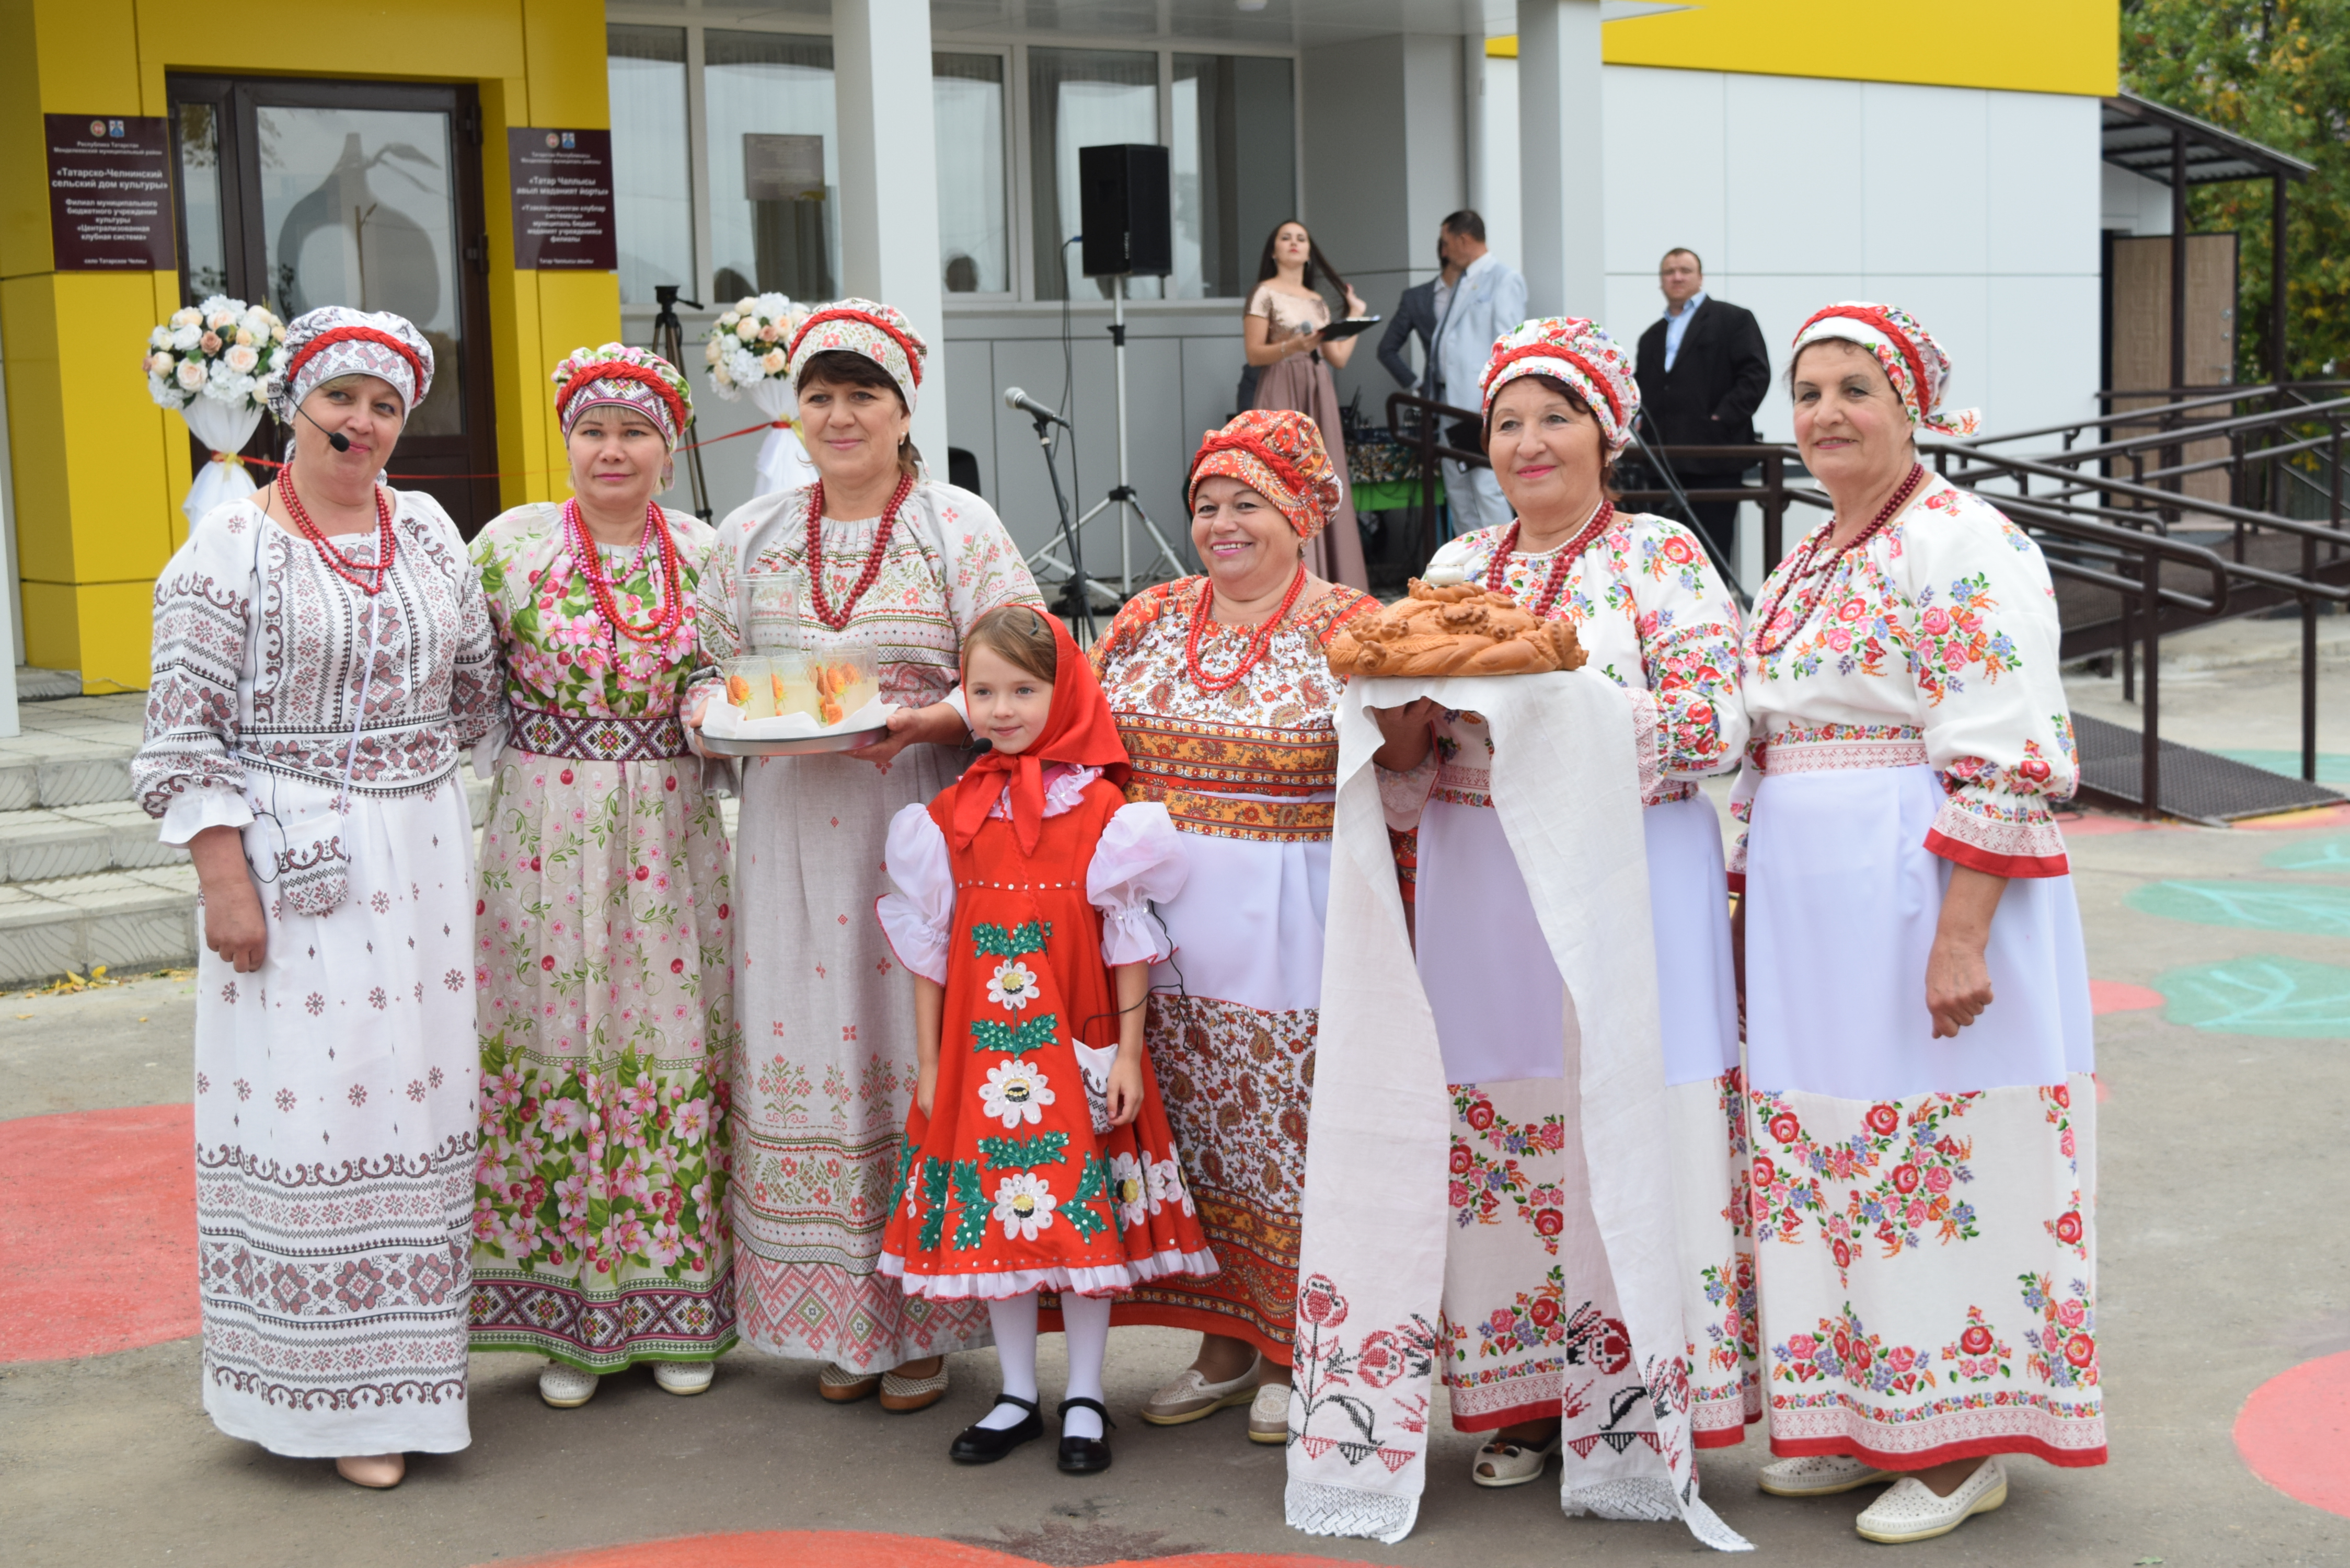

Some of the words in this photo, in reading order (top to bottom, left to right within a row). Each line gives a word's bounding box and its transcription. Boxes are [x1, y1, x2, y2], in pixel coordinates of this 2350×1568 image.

[57, 167, 163, 178] «Татарско-Челнинский
[98, 181, 117, 189] дом
[120, 181, 168, 191] культуры»
[77, 224, 150, 233] «Централизованная
[81, 233, 111, 241] клубная
